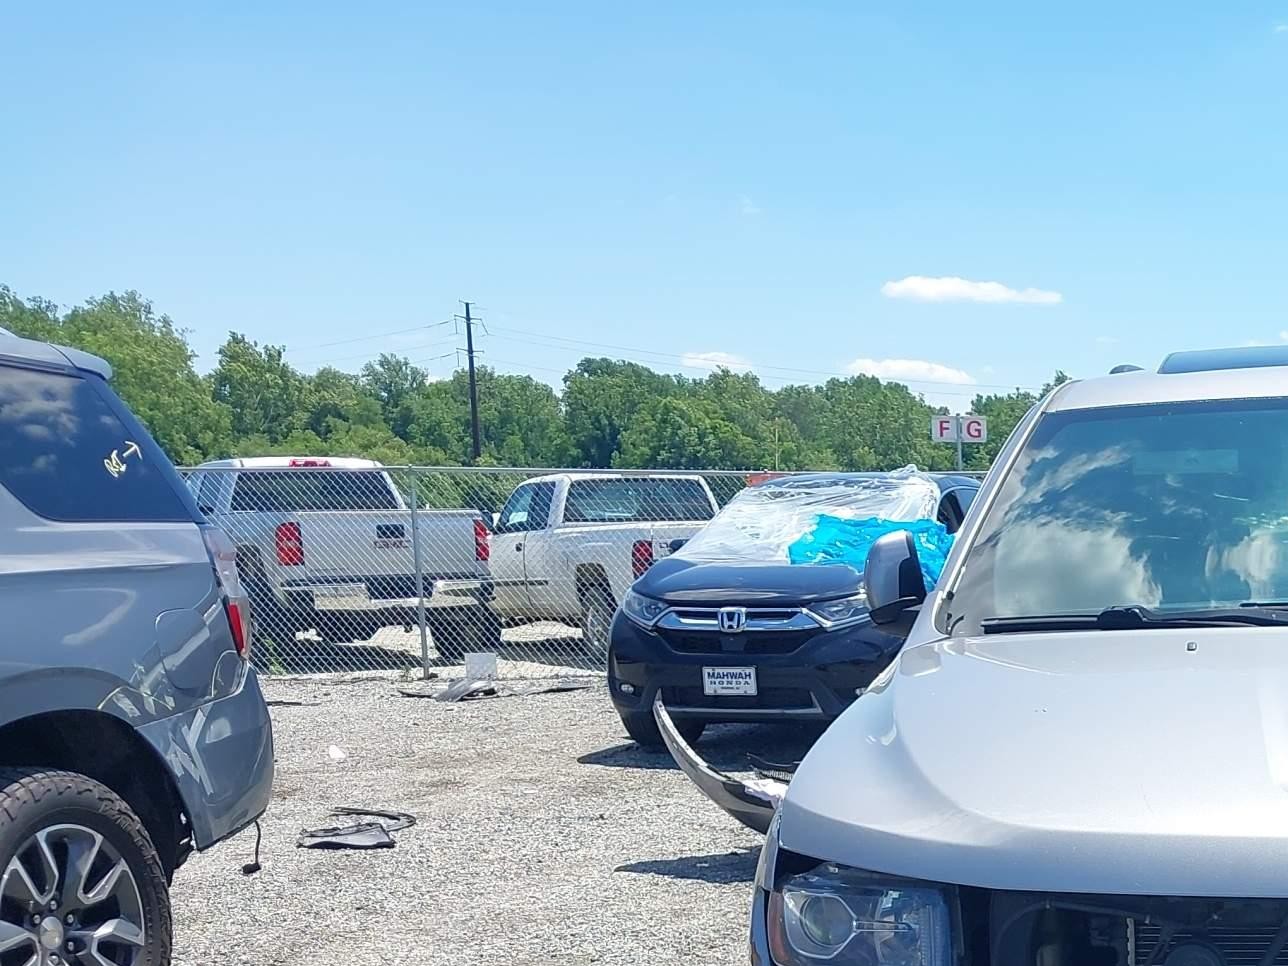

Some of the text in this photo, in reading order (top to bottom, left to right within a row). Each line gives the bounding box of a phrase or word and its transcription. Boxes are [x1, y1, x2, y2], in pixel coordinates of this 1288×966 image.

[939, 420, 950, 438] F
[966, 420, 982, 438] G
[706, 671, 752, 680] MAHWAH
